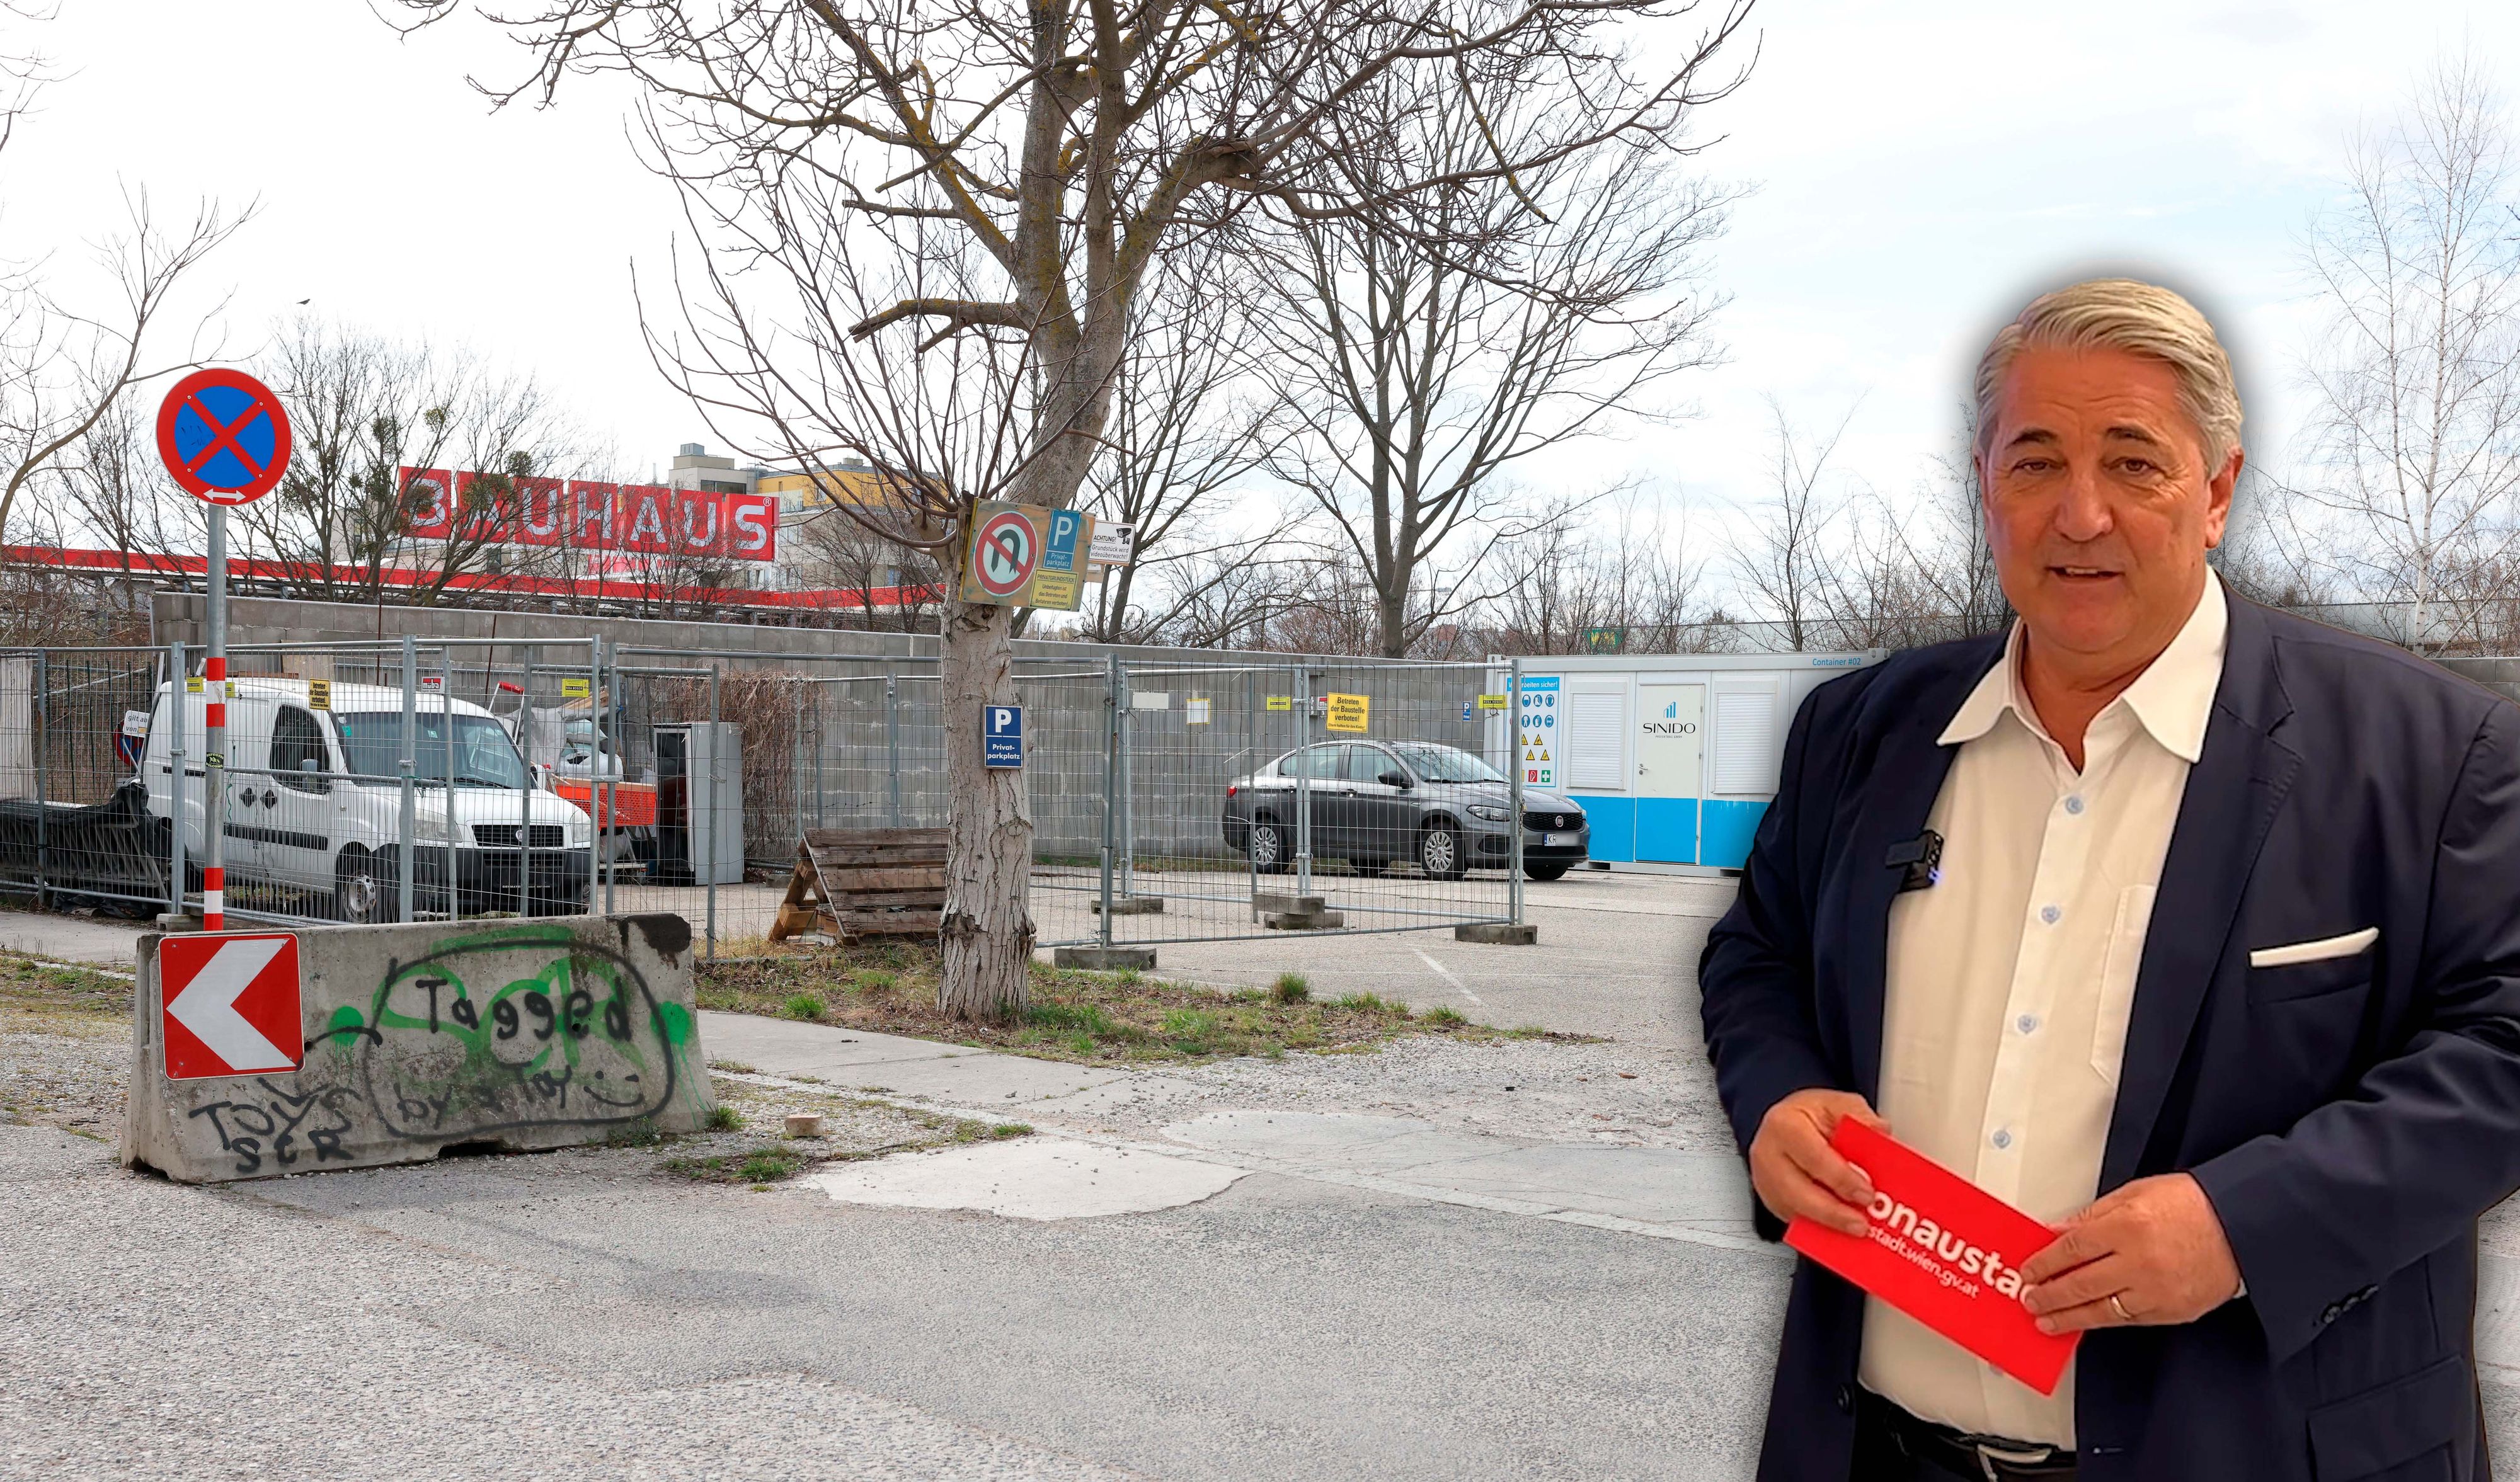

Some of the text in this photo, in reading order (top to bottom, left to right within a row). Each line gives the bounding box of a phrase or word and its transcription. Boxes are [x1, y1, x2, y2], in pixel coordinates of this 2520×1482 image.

[410, 477, 767, 551] BAUHAUS
[1053, 516, 1073, 546] P
[1051, 552, 1067, 561] Privat-
[1091, 551, 1128, 559] videoüberwacht!
[1037, 574, 1075, 583] PRIVATGRUNDSTÜCK
[1813, 658, 1861, 666] Container #02
[1337, 697, 1359, 705] Betreten
[1341, 705, 1365, 714] Baustelle
[995, 709, 1012, 733] P
[1334, 714, 1360, 722] verboten!
[1642, 722, 1696, 734] SINIDO
[987, 752, 1021, 761] parkplatz
[415, 976, 631, 1042] Tagged
[1848, 1161, 2035, 1305] onausta
